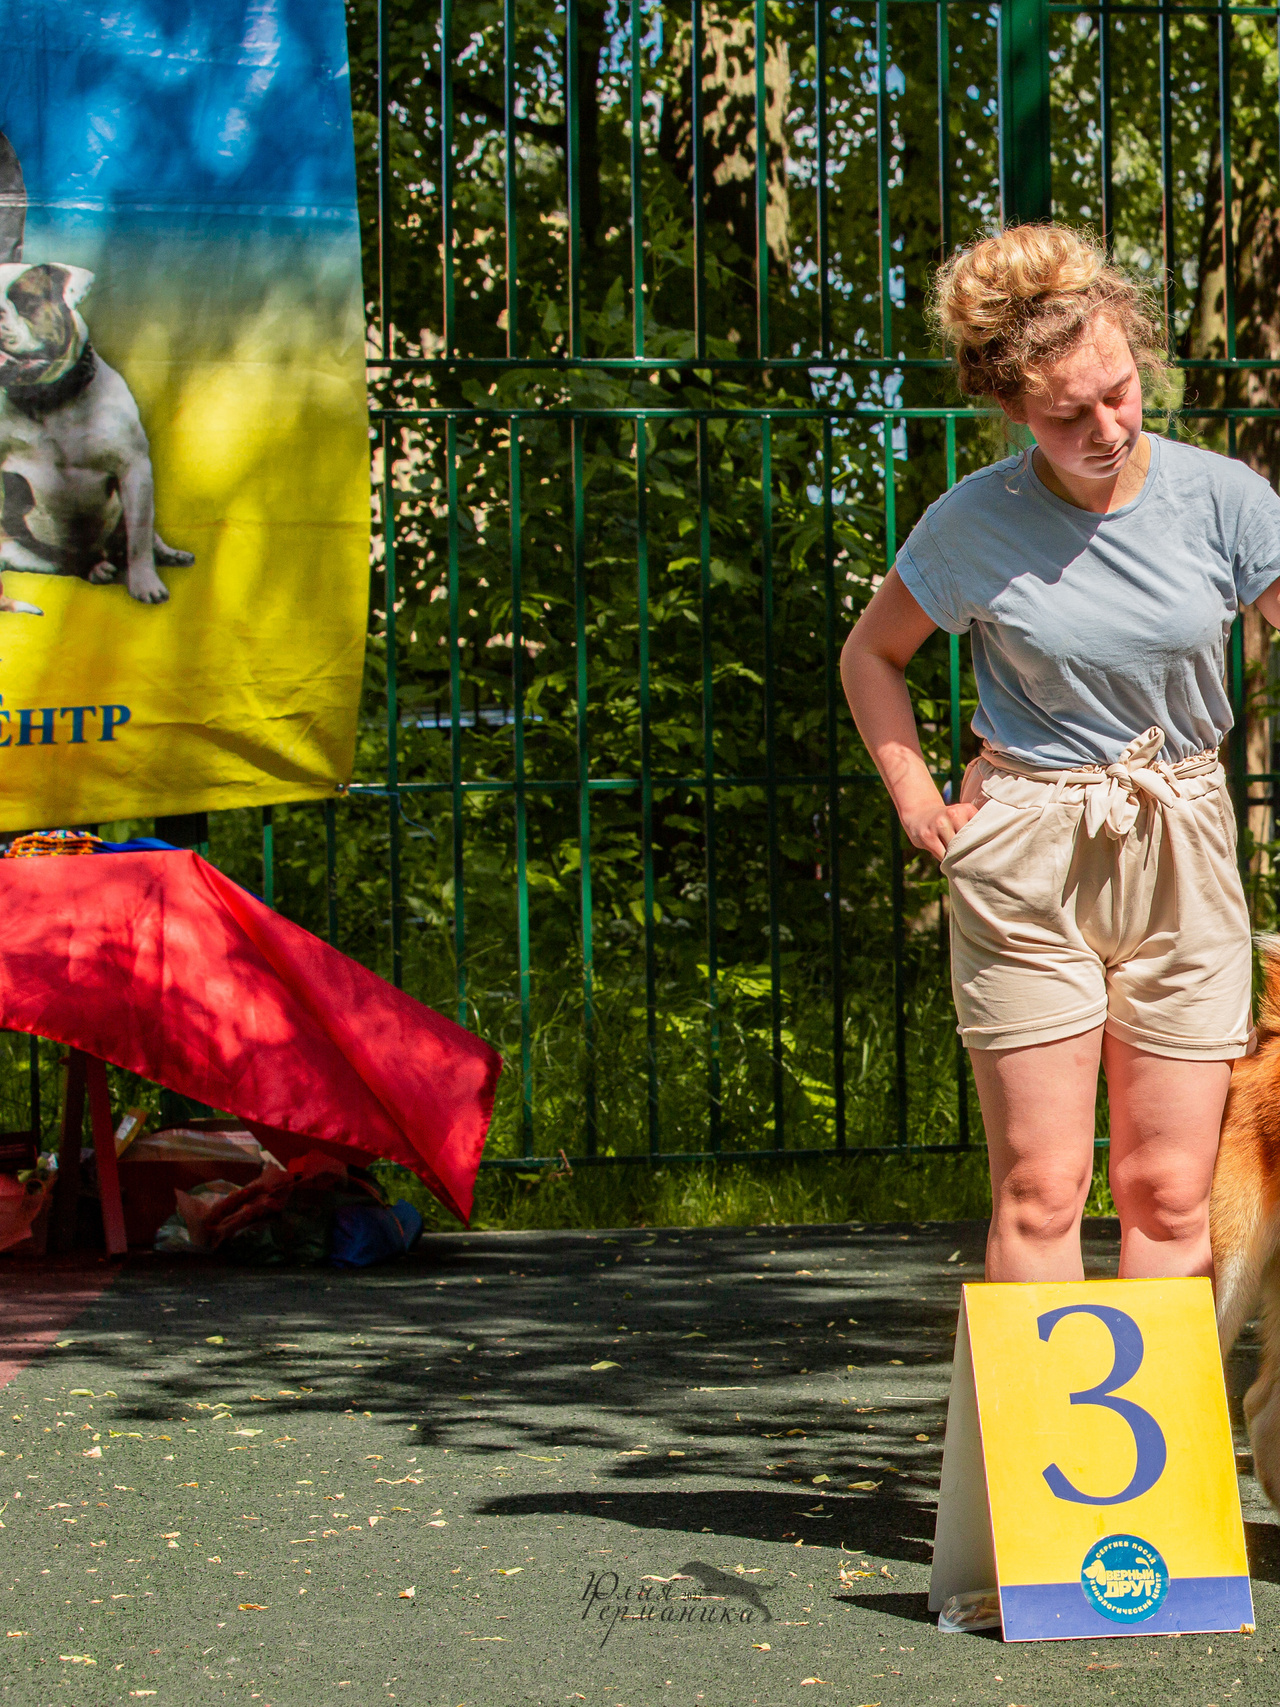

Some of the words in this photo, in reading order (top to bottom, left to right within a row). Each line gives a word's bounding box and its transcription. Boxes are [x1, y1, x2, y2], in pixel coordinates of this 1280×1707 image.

[1036, 1303, 1168, 1506] 3
[1095, 1541, 1129, 1559] СЕРГИЕВ
[1131, 1543, 1156, 1564] ПОСАД
[1090, 1580, 1153, 1615] КИНОЛОГИЧЕСКИЙ
[1151, 1572, 1162, 1600] ЦЕНТР
[1103, 1580, 1155, 1598] ДРУГ
